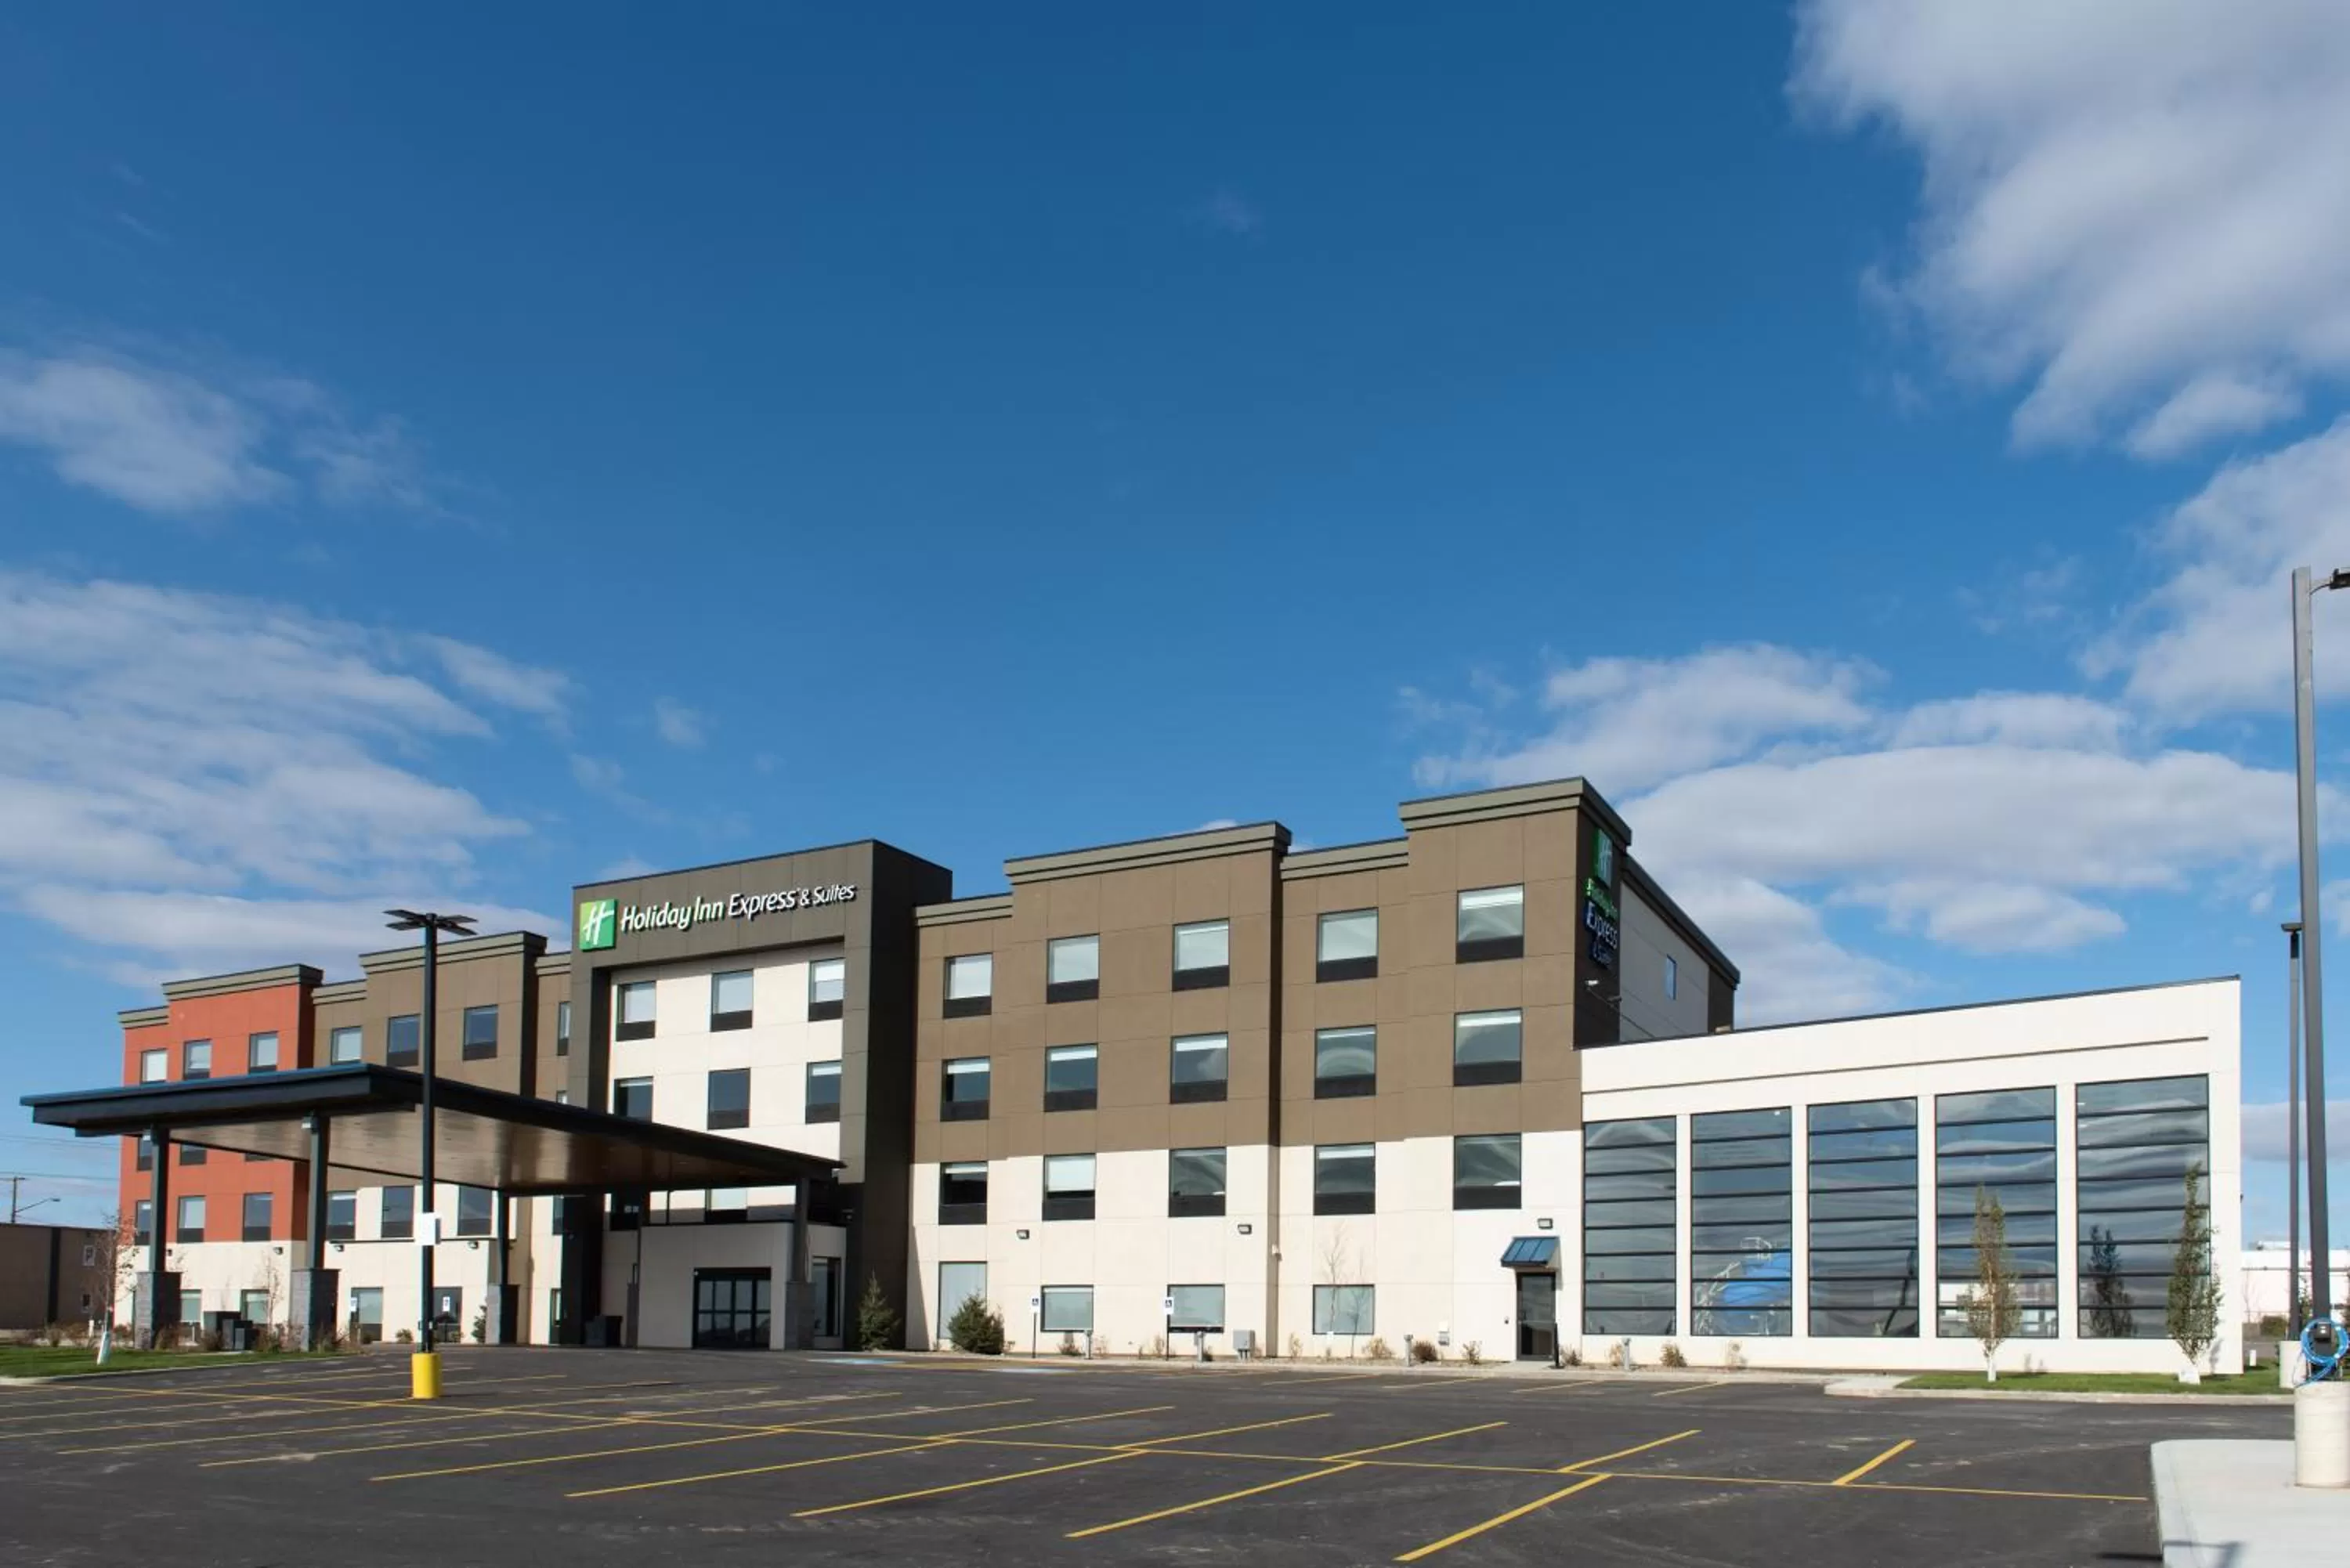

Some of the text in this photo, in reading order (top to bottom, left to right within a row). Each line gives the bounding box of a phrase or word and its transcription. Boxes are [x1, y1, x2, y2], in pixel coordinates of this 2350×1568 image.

[620, 883, 855, 932] Holiday Inn Express & Suites
